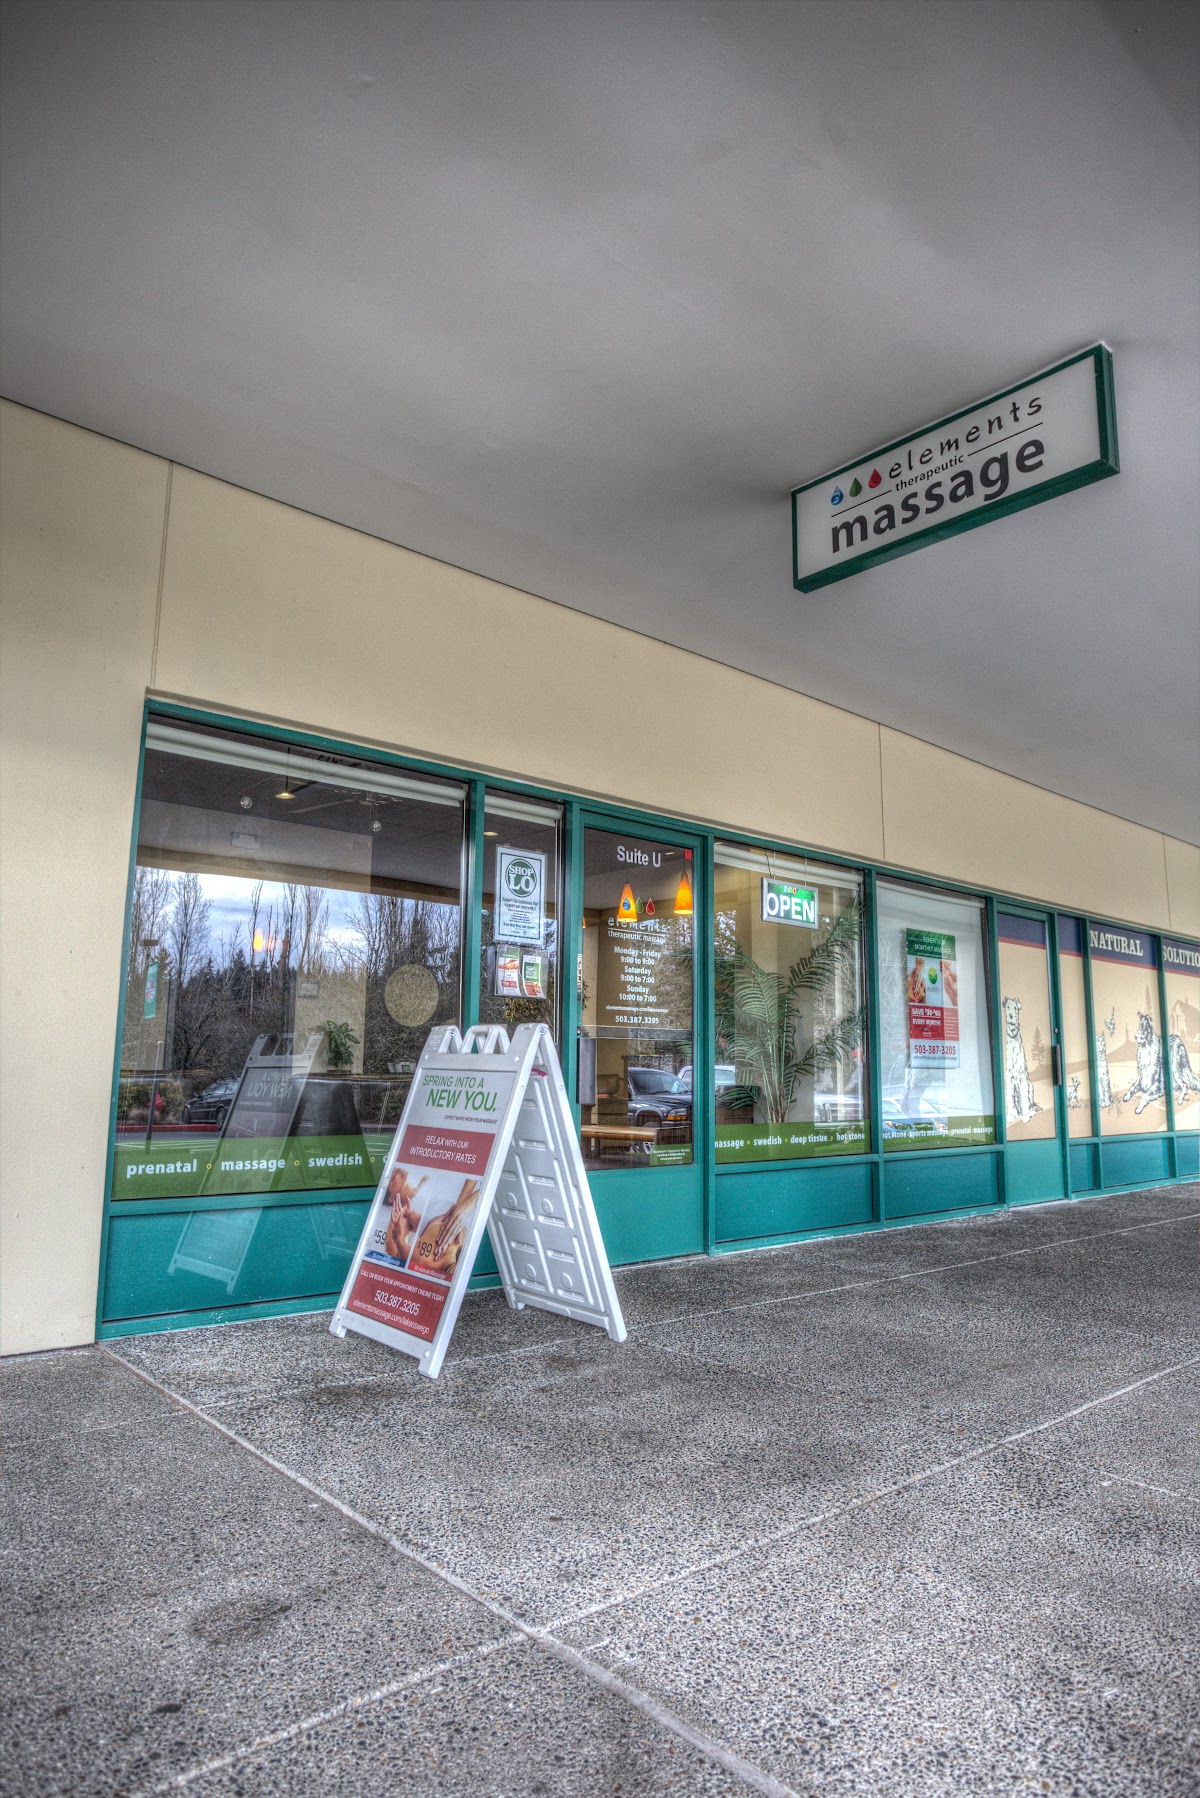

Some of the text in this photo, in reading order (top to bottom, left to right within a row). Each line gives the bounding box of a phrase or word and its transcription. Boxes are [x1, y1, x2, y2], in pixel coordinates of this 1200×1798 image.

[888, 396, 1043, 479] elements
[896, 454, 964, 492] therapeutic
[831, 439, 1045, 554] massage
[617, 846, 661, 868] Suite U
[509, 865, 534, 877] SHOP
[509, 874, 534, 891] LO
[766, 892, 815, 923] OPEN
[608, 916, 667, 932] elements
[608, 930, 667, 945] therapeutic massage
[1089, 930, 1144, 957] NATURAL
[614, 946, 639, 956] Monday
[643, 950, 662, 959] Friday
[624, 966, 651, 976] Saturday
[626, 985, 649, 994] Sunday
[615, 1016, 660, 1024] 503.387.3205
[912, 1008, 924, 1016] SAVE
[914, 1045, 956, 1055] 503-387-3205
[423, 1075, 484, 1088] SPRING INTO A
[426, 1089, 497, 1112] NEW YOU.
[753, 1136, 782, 1146] swedish
[790, 1135, 807, 1145] deep
[808, 1134, 828, 1142] tissue
[836, 1132, 847, 1141] hot
[848, 1132, 865, 1140] stone
[909, 1130, 927, 1139] sports
[927, 1129, 948, 1137] massage
[951, 1127, 972, 1136] prenatal
[973, 1127, 993, 1135] massage
[425, 1135, 469, 1149] RELAX WITH OUR
[409, 1146, 477, 1164] INTRODUCTORY RATES
[126, 1152, 363, 1178] prenatal massage swedish
[374, 1229, 388, 1245] $59
[417, 1241, 433, 1258] $89
[374, 1273, 384, 1281] BOOK
[384, 1276, 393, 1285] YOUR
[393, 1280, 418, 1293] APPOINTMENT
[374, 1290, 420, 1316] 503.387.3205
